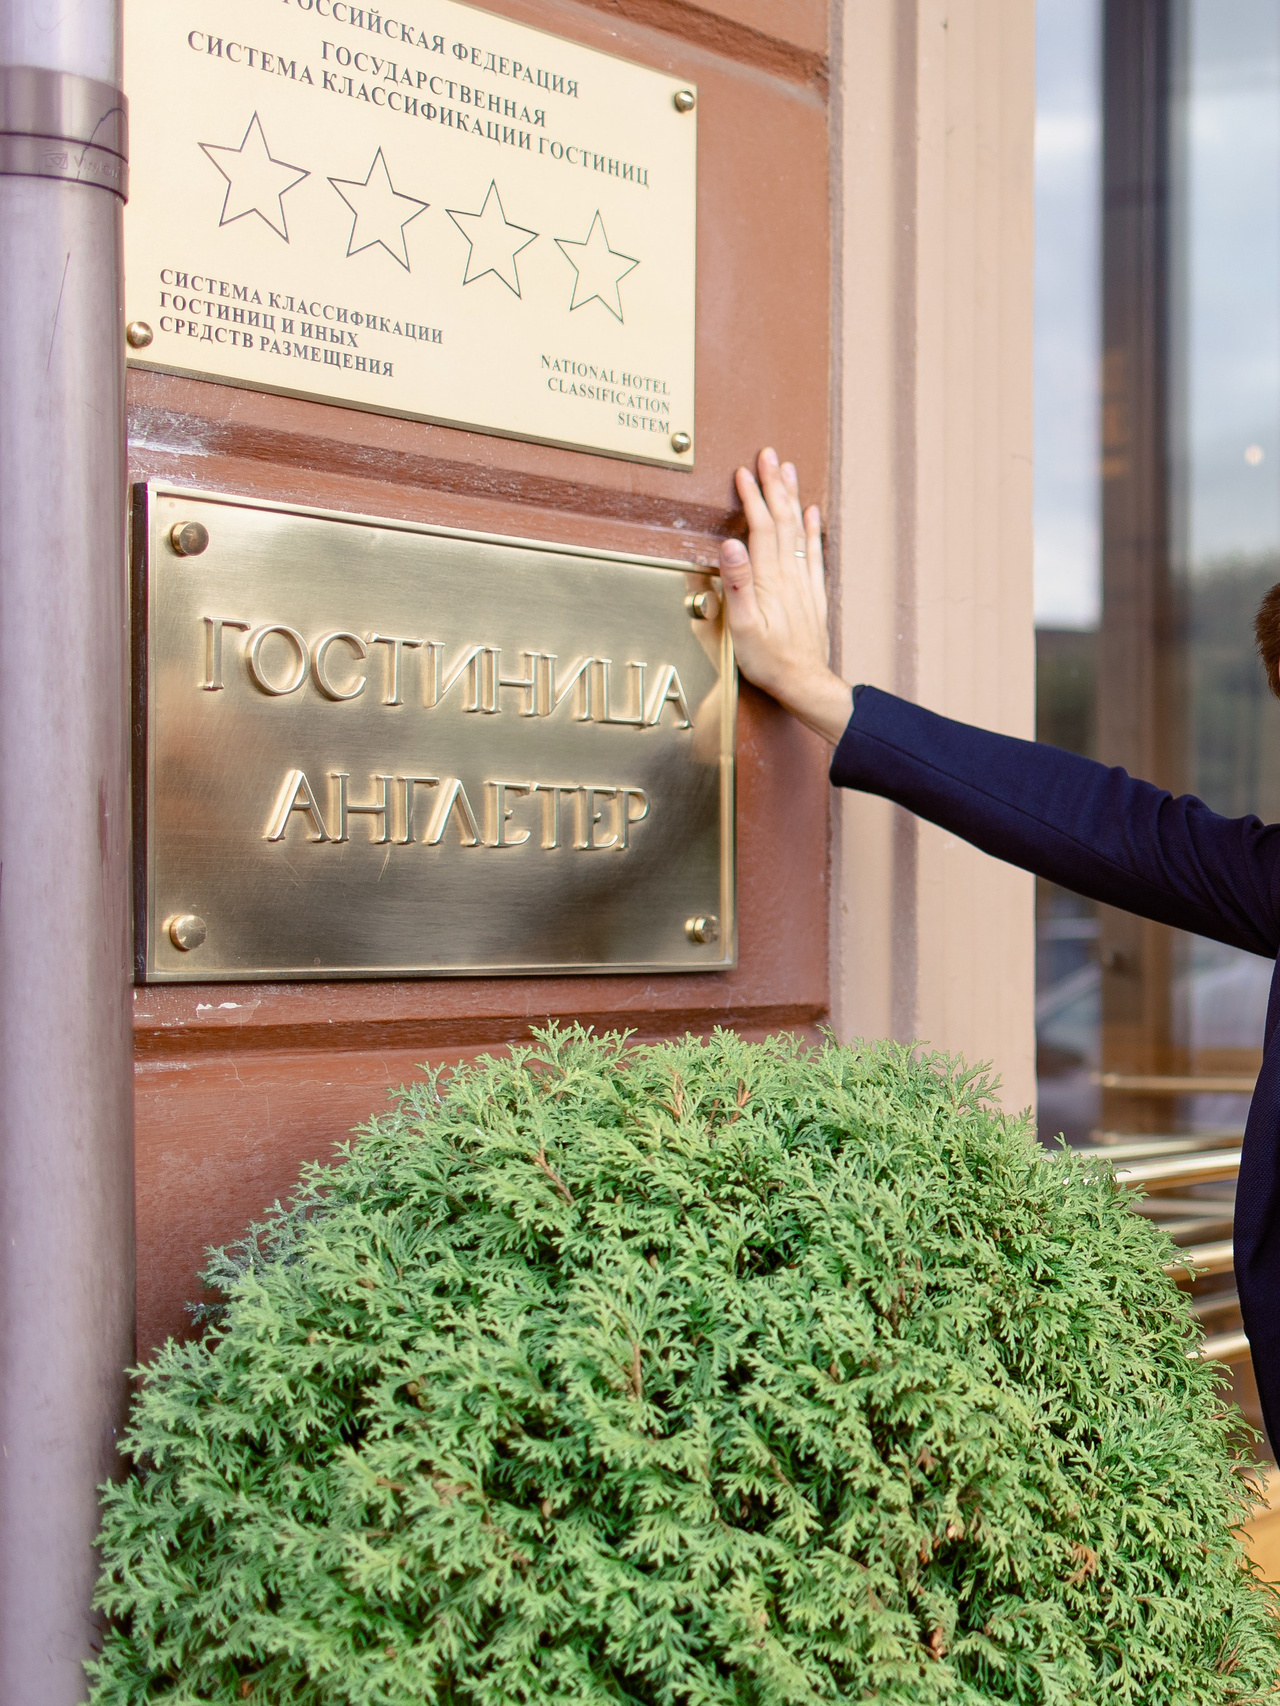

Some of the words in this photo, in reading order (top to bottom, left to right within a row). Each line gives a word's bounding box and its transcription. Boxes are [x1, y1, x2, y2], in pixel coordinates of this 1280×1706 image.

[282, 0, 445, 56] ОССИЙСКАЯ
[451, 43, 579, 98] ФЕДЕРАЦИЯ
[321, 40, 546, 127] ГОСУДАРСТВЕННАЯ
[187, 31, 315, 86] СИСТЕМА
[321, 70, 532, 150] КЛАССИФИКАЦИИ
[539, 137, 650, 188] ГОСТИНИЦ
[159, 268, 263, 306] СИСТЕМА
[268, 292, 444, 345] КЛАССИФИКАЦИИ
[159, 291, 276, 333] ГОСТИНИЦ
[281, 318, 295, 335] И
[300, 322, 359, 349] ИНЫХ
[159, 316, 254, 349] СРЕДСТВ
[259, 335, 394, 378] РАЗМЕЩЕНИЯ
[541, 354, 619, 385] NATIONAL
[621, 373, 671, 396] HOTEL
[547, 377, 670, 414] CLASSIFICATION
[617, 412, 670, 435] SISTEM
[201, 615, 692, 728] ГОСТИНИЦА
[263, 768, 652, 851] АНГЛЕТЕР
